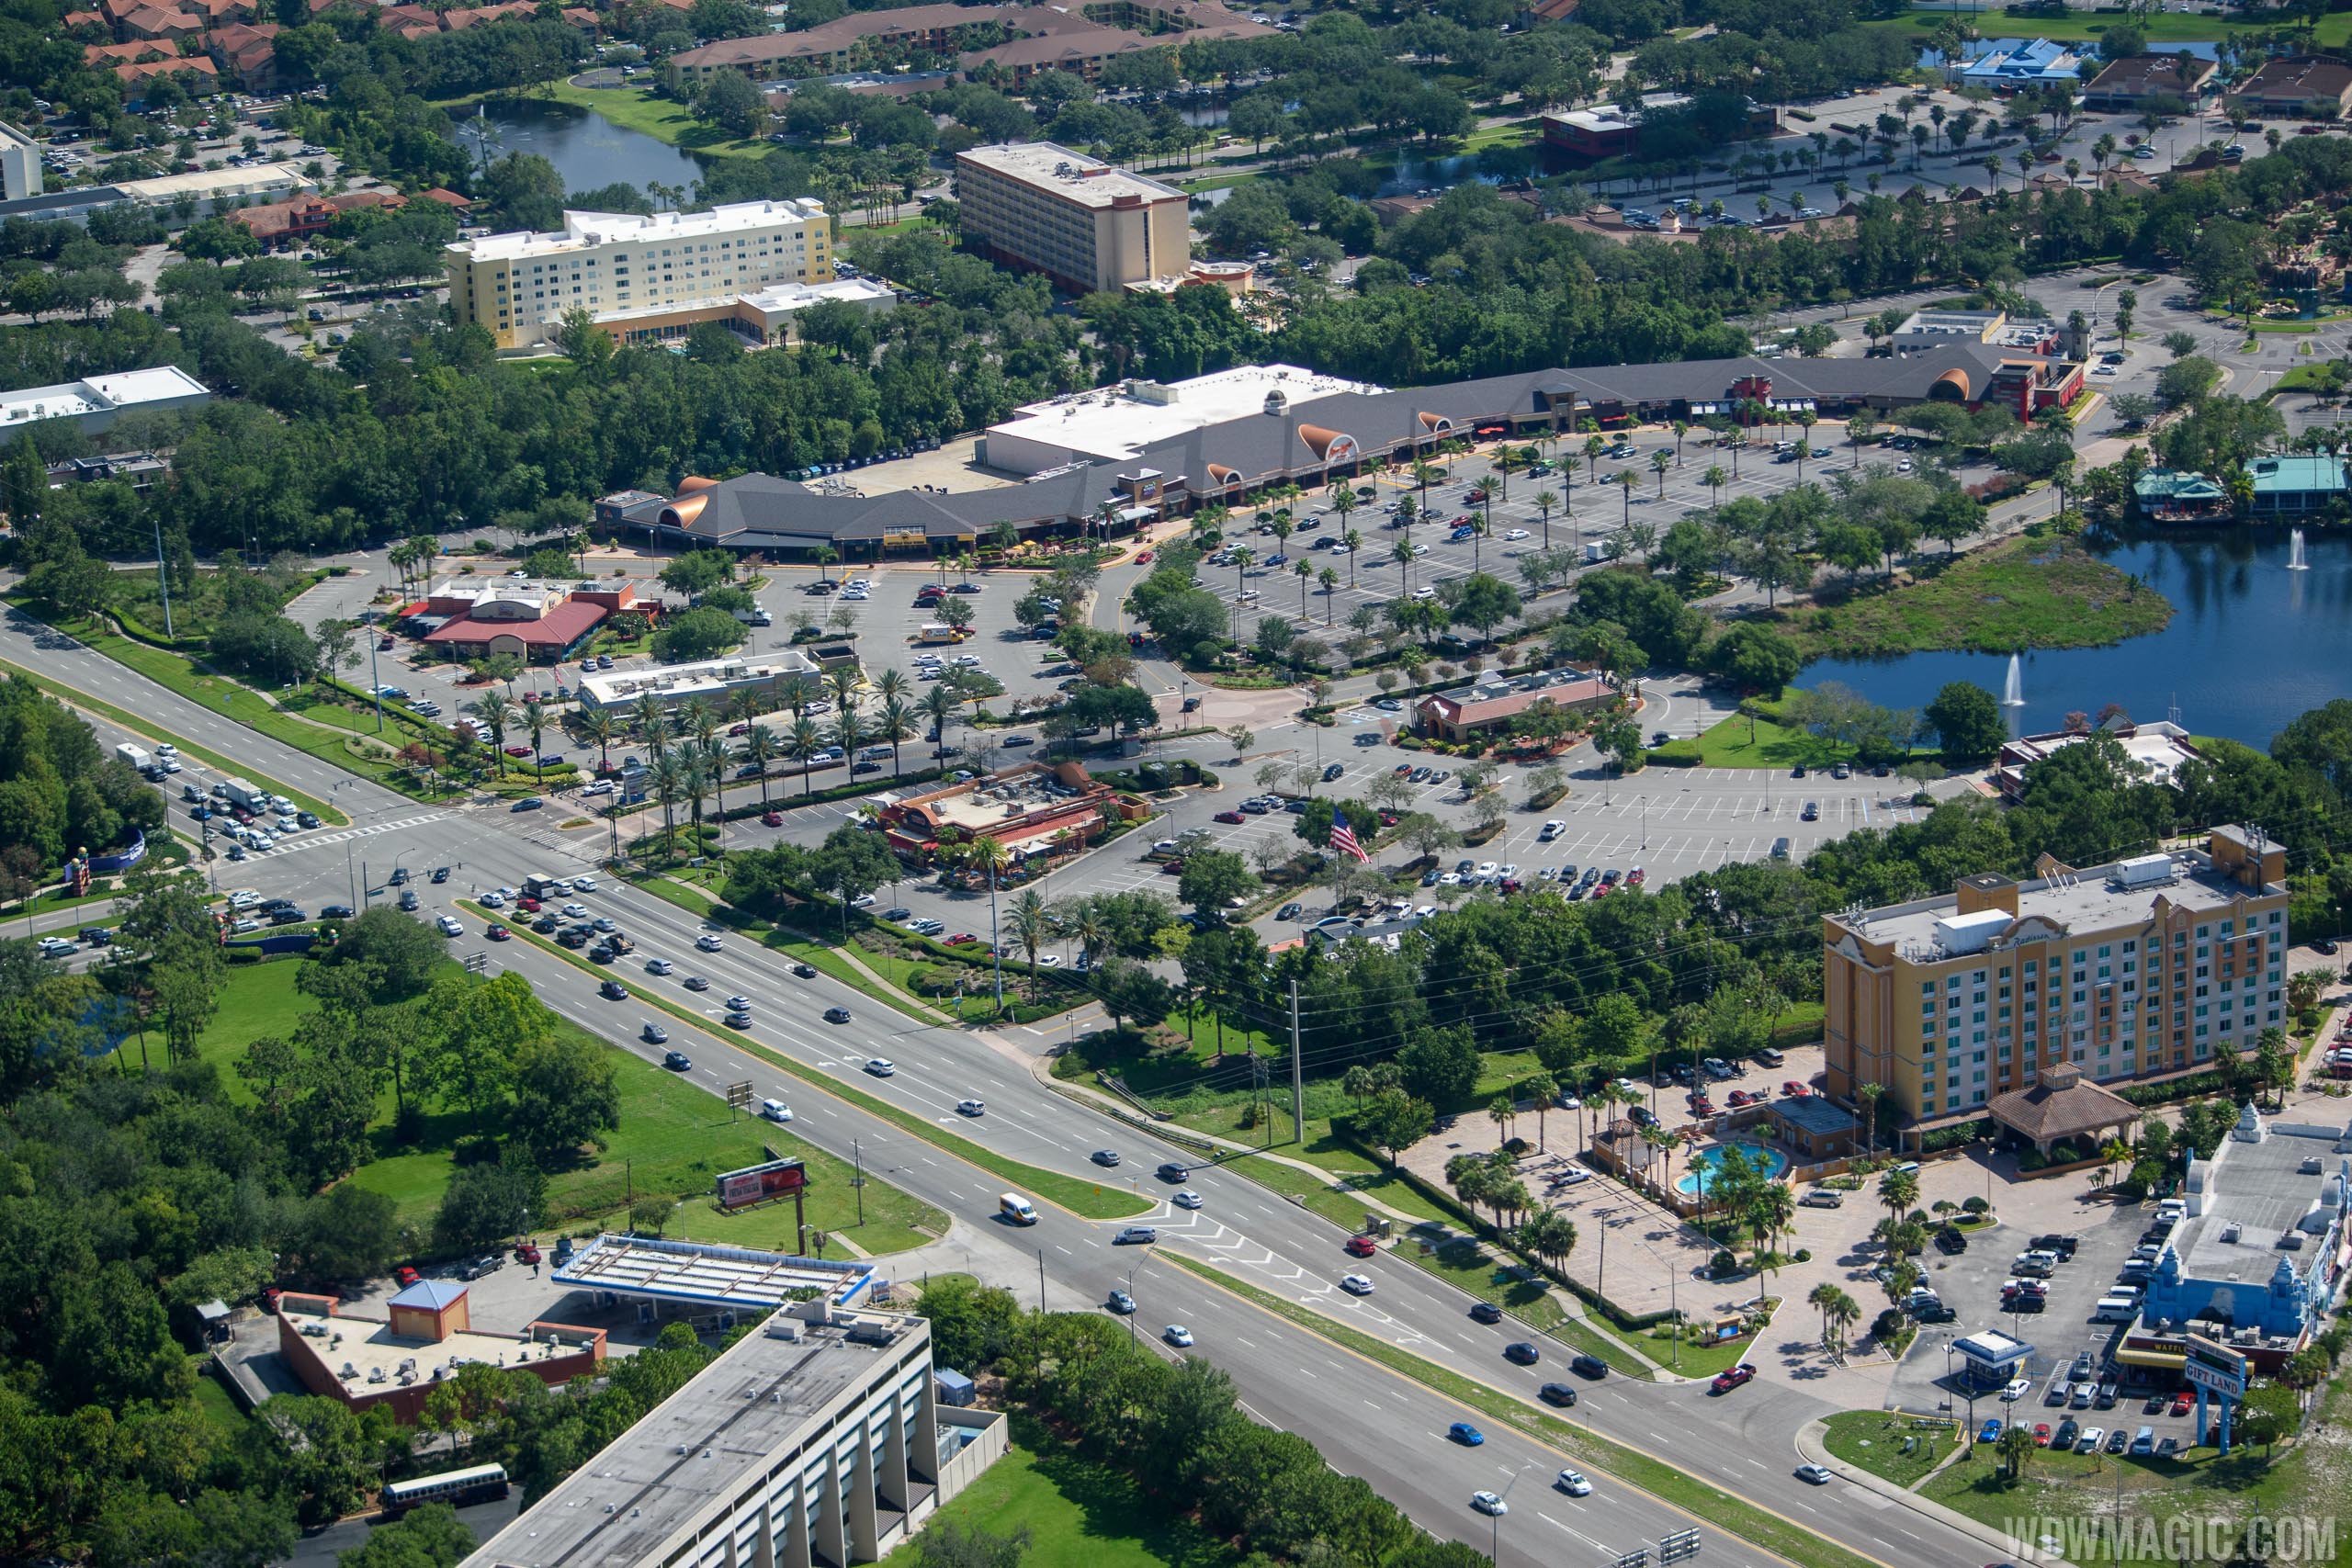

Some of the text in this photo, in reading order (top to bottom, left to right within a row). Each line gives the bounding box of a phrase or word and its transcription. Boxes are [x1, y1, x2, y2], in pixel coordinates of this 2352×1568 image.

[2014, 933, 2050, 947] Radisson
[2187, 1364, 2238, 1394] GIFT LAND
